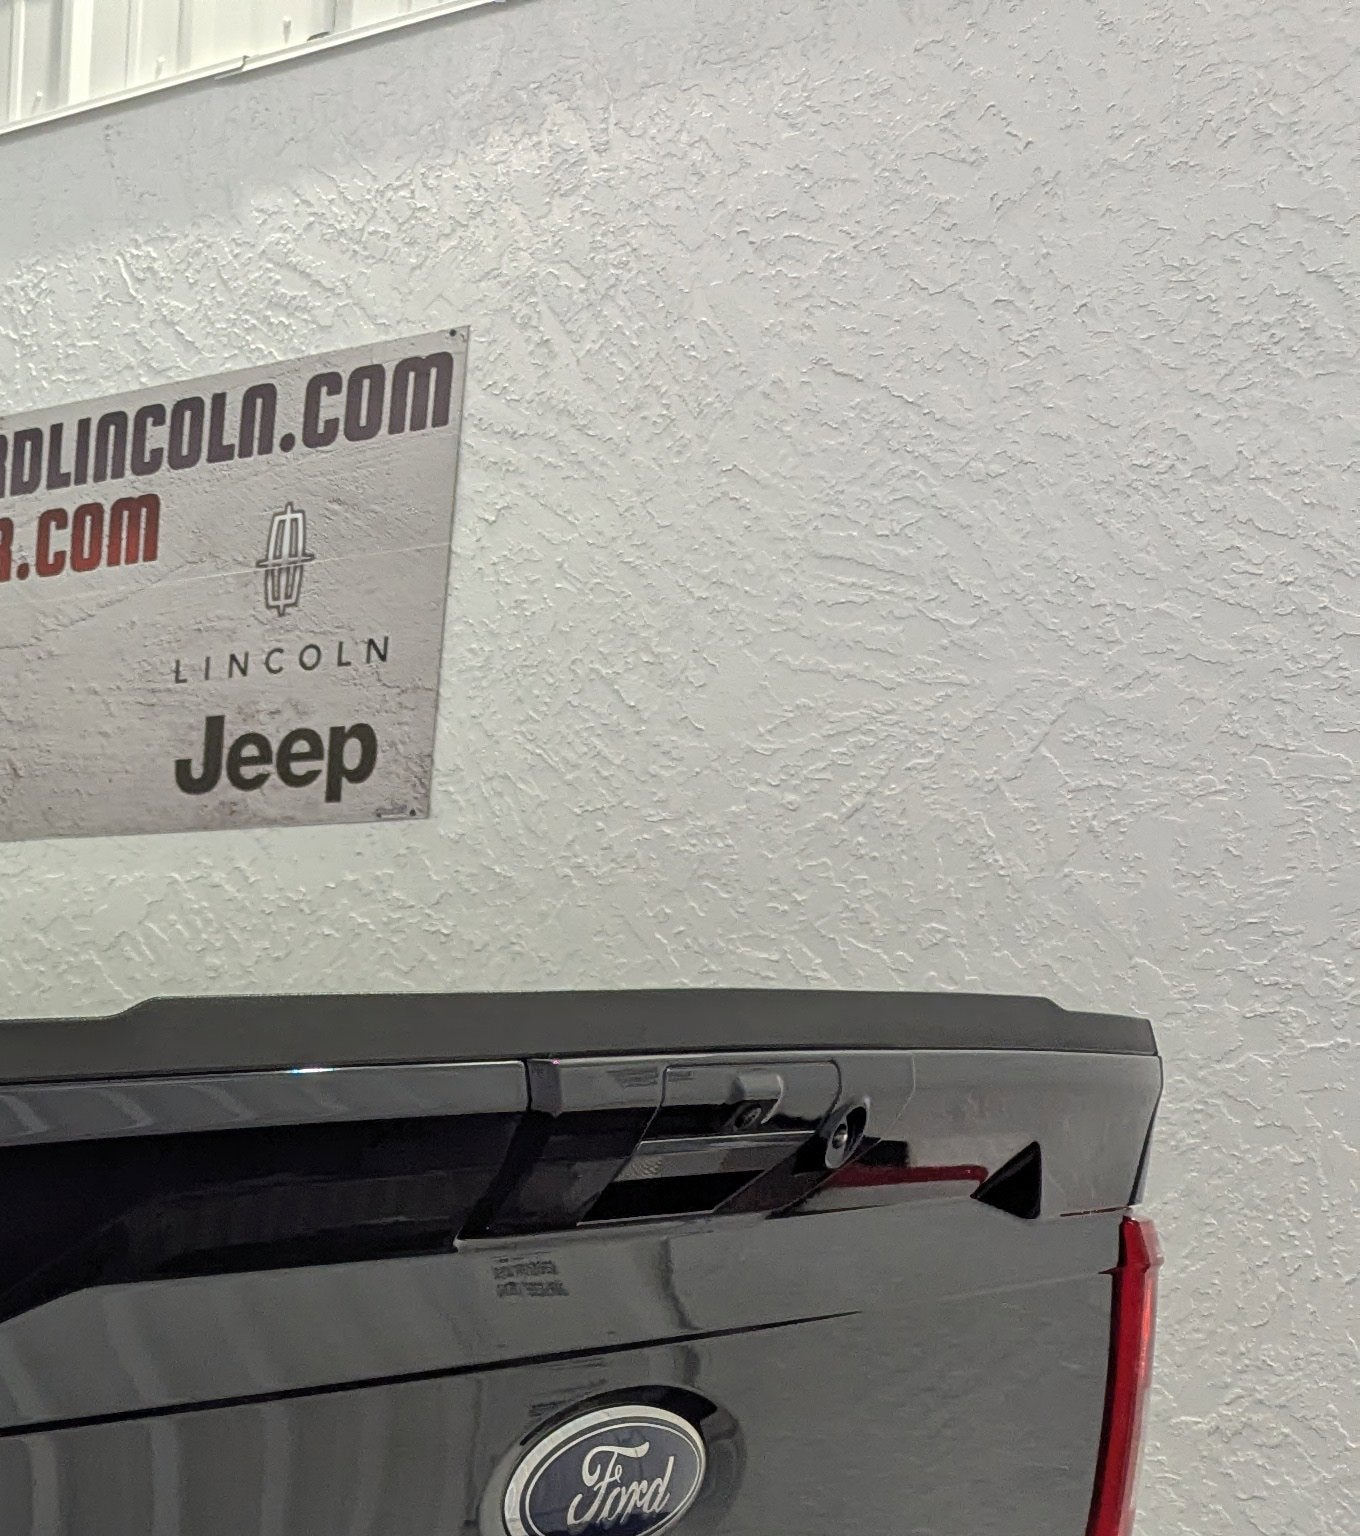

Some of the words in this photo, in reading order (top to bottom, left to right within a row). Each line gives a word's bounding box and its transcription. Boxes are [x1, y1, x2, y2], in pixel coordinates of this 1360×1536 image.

[174, 635, 389, 684] LINCOLN
[174, 714, 378, 803] Jeep
[566, 1441, 675, 1530] Ford
